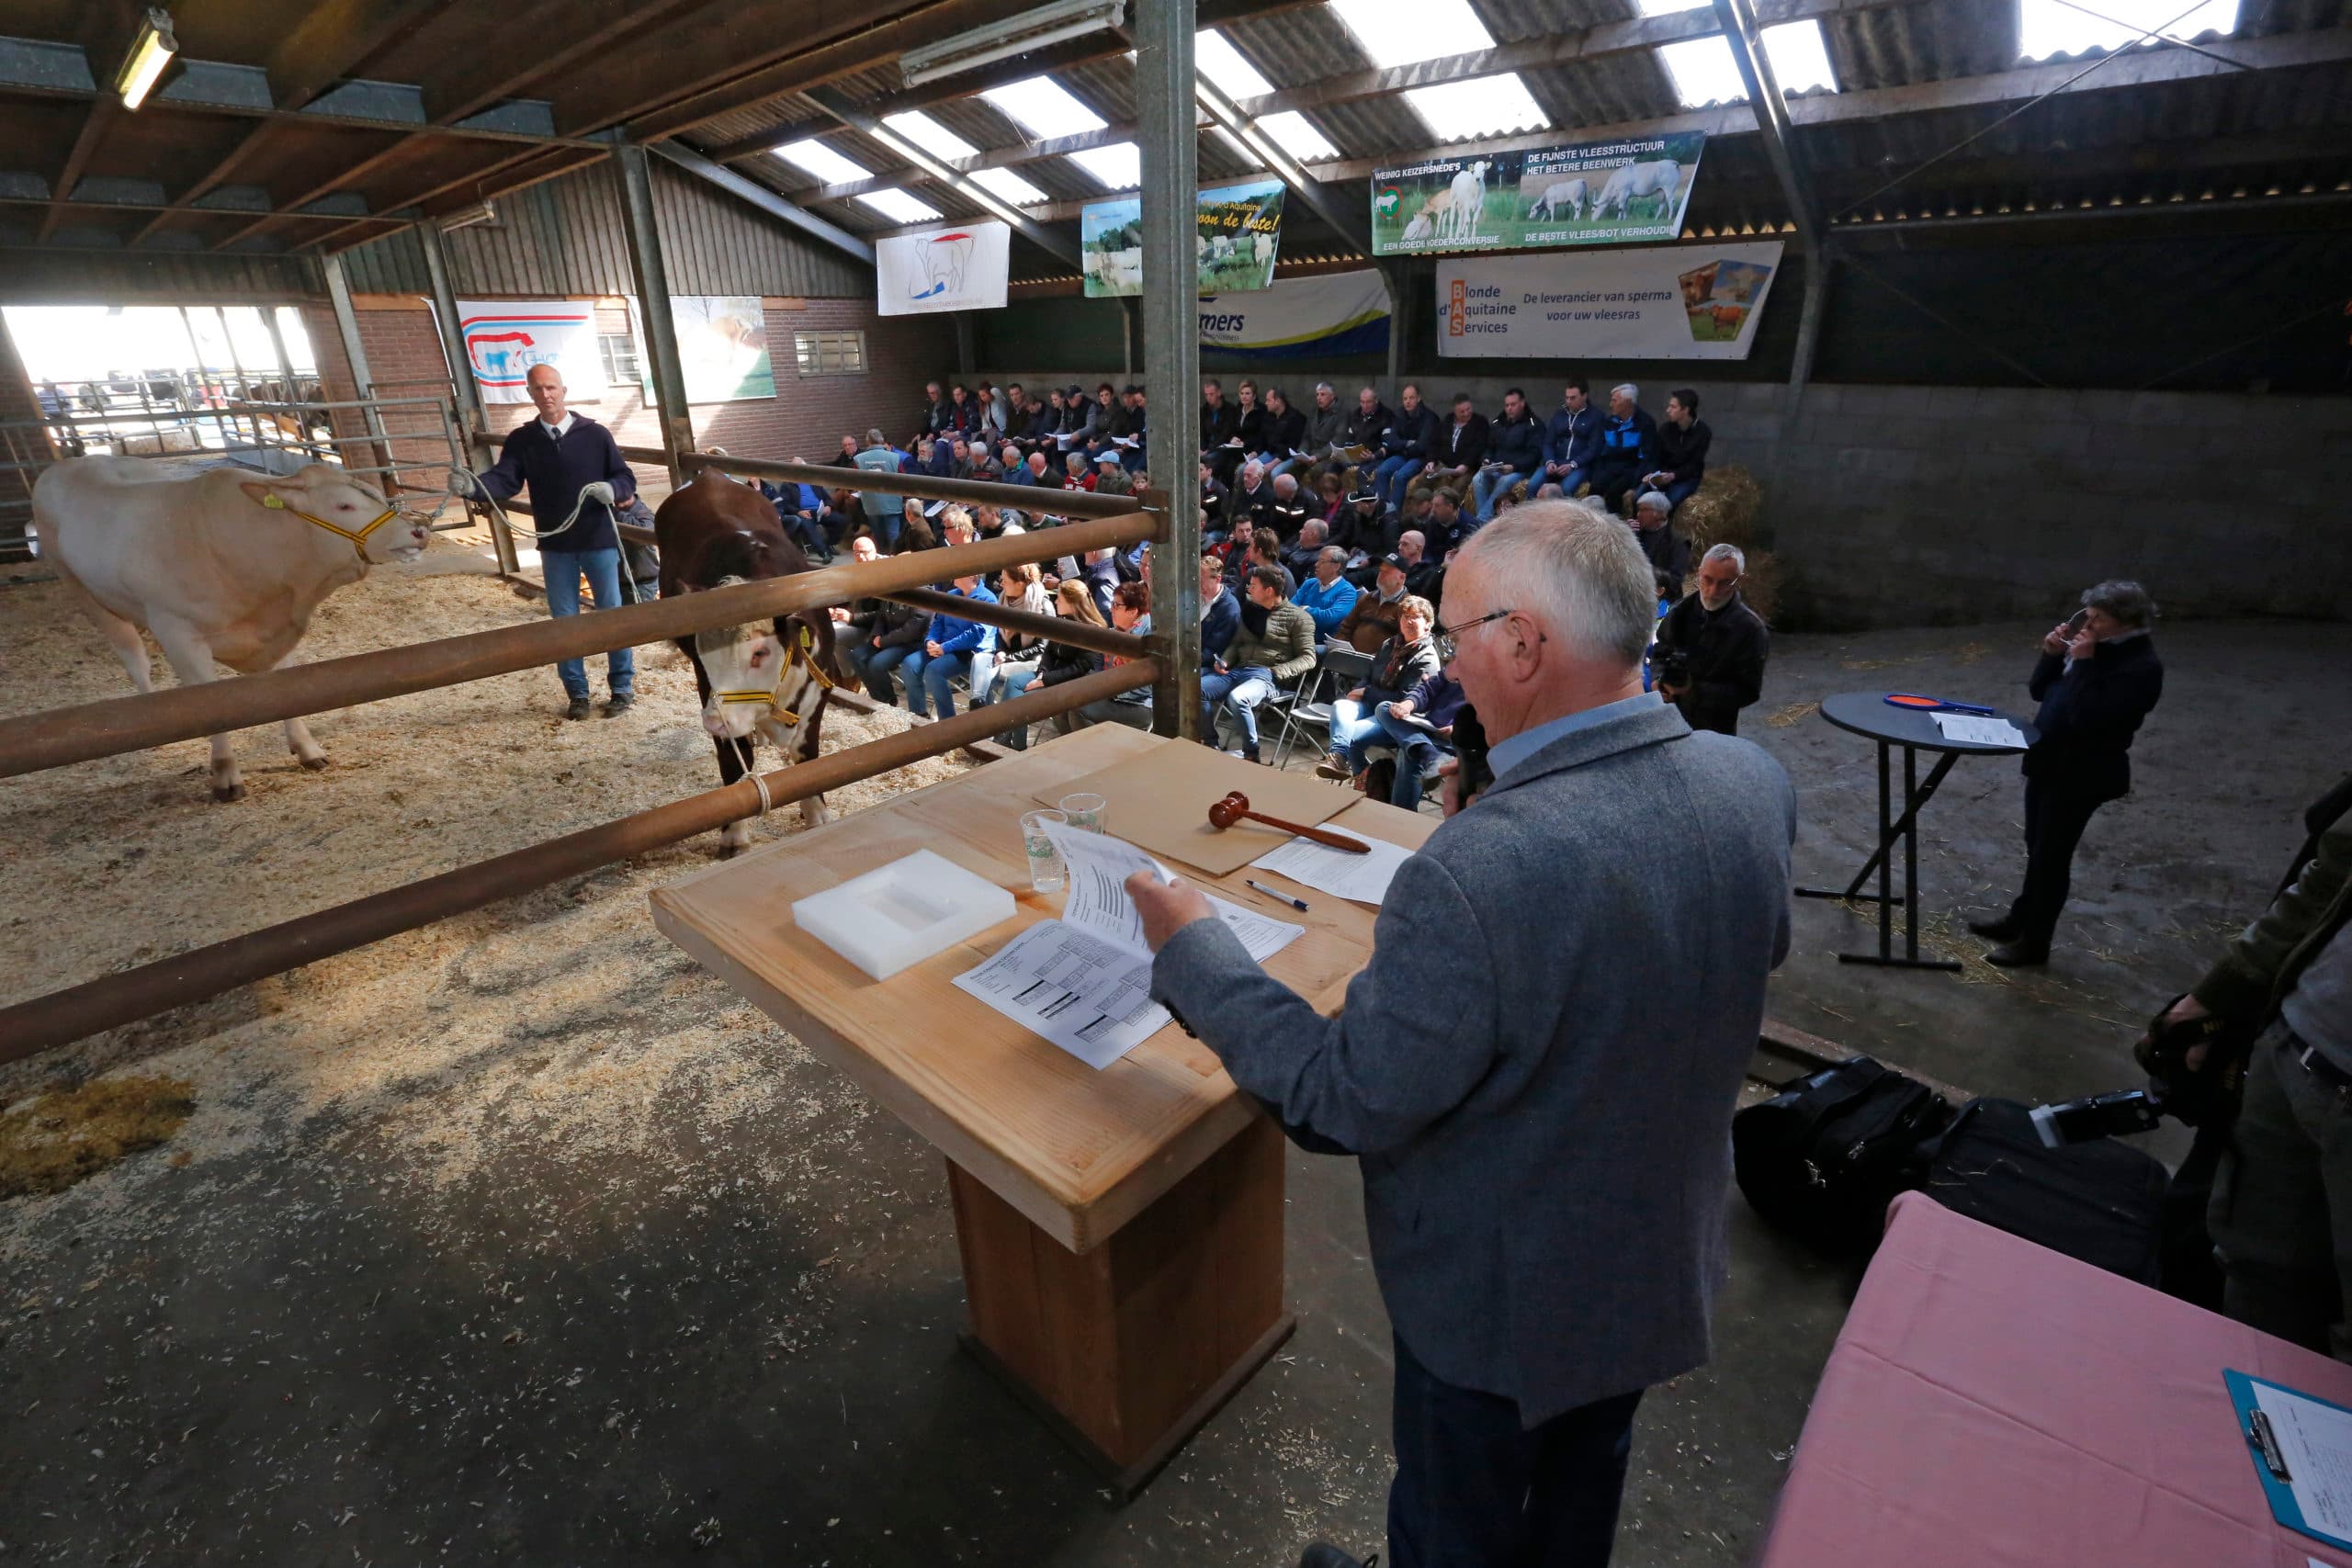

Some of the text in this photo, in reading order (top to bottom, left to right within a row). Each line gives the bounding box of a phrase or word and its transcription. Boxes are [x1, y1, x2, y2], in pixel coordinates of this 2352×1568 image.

[1528, 141, 1665, 164] DE FIJNSTE VLEESSTRUCTUUR
[1374, 163, 1461, 180] WEINIG KEIZERSNEDE'S
[1527, 156, 1636, 175] HET BETERE BEENWERK
[1223, 211, 1239, 227] de
[1242, 211, 1280, 231] beste!
[1525, 232, 1537, 242] DE
[1539, 231, 1567, 242] BESTE
[1569, 228, 1619, 240] VLEES/BOT
[1383, 243, 1398, 251] EEN
[1399, 240, 1425, 249] GOEDE
[1453, 284, 1500, 299] Blonde
[1523, 291, 1672, 306] De leverancier van sperma
[1439, 302, 1517, 318] d'Aquitaine
[1546, 309, 1641, 321] voor uw vleesras
[1198, 312, 1245, 332] mers
[1452, 320, 1509, 333] Services
